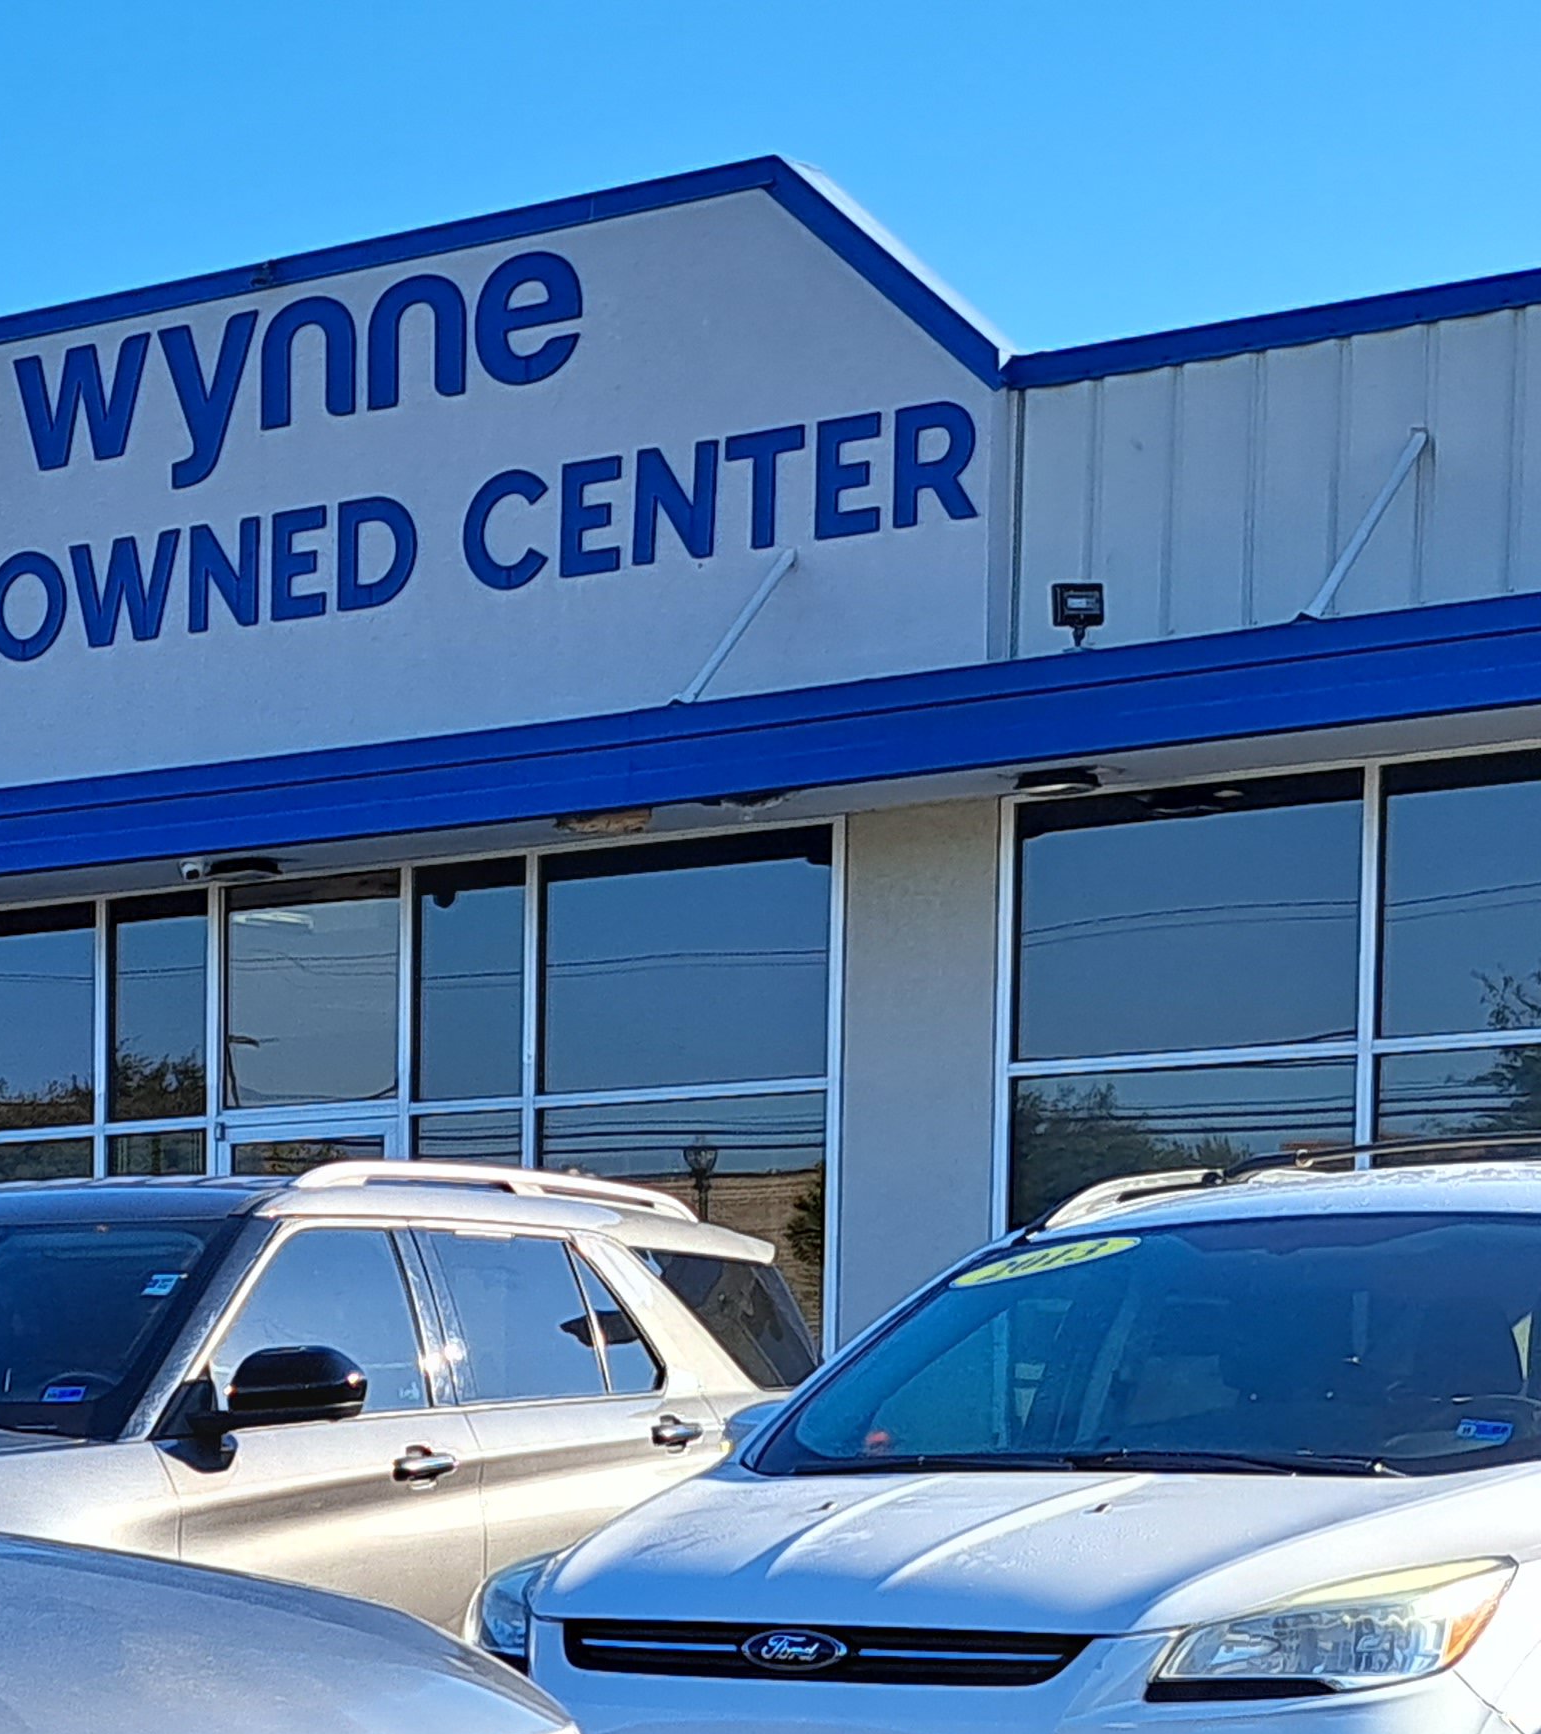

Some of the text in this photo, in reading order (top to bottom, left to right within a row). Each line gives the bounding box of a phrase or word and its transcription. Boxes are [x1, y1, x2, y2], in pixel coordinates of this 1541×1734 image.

[13, 250, 584, 489] wynne
[462, 400, 980, 593] CENTER
[760, 1634, 820, 1663] Ford
